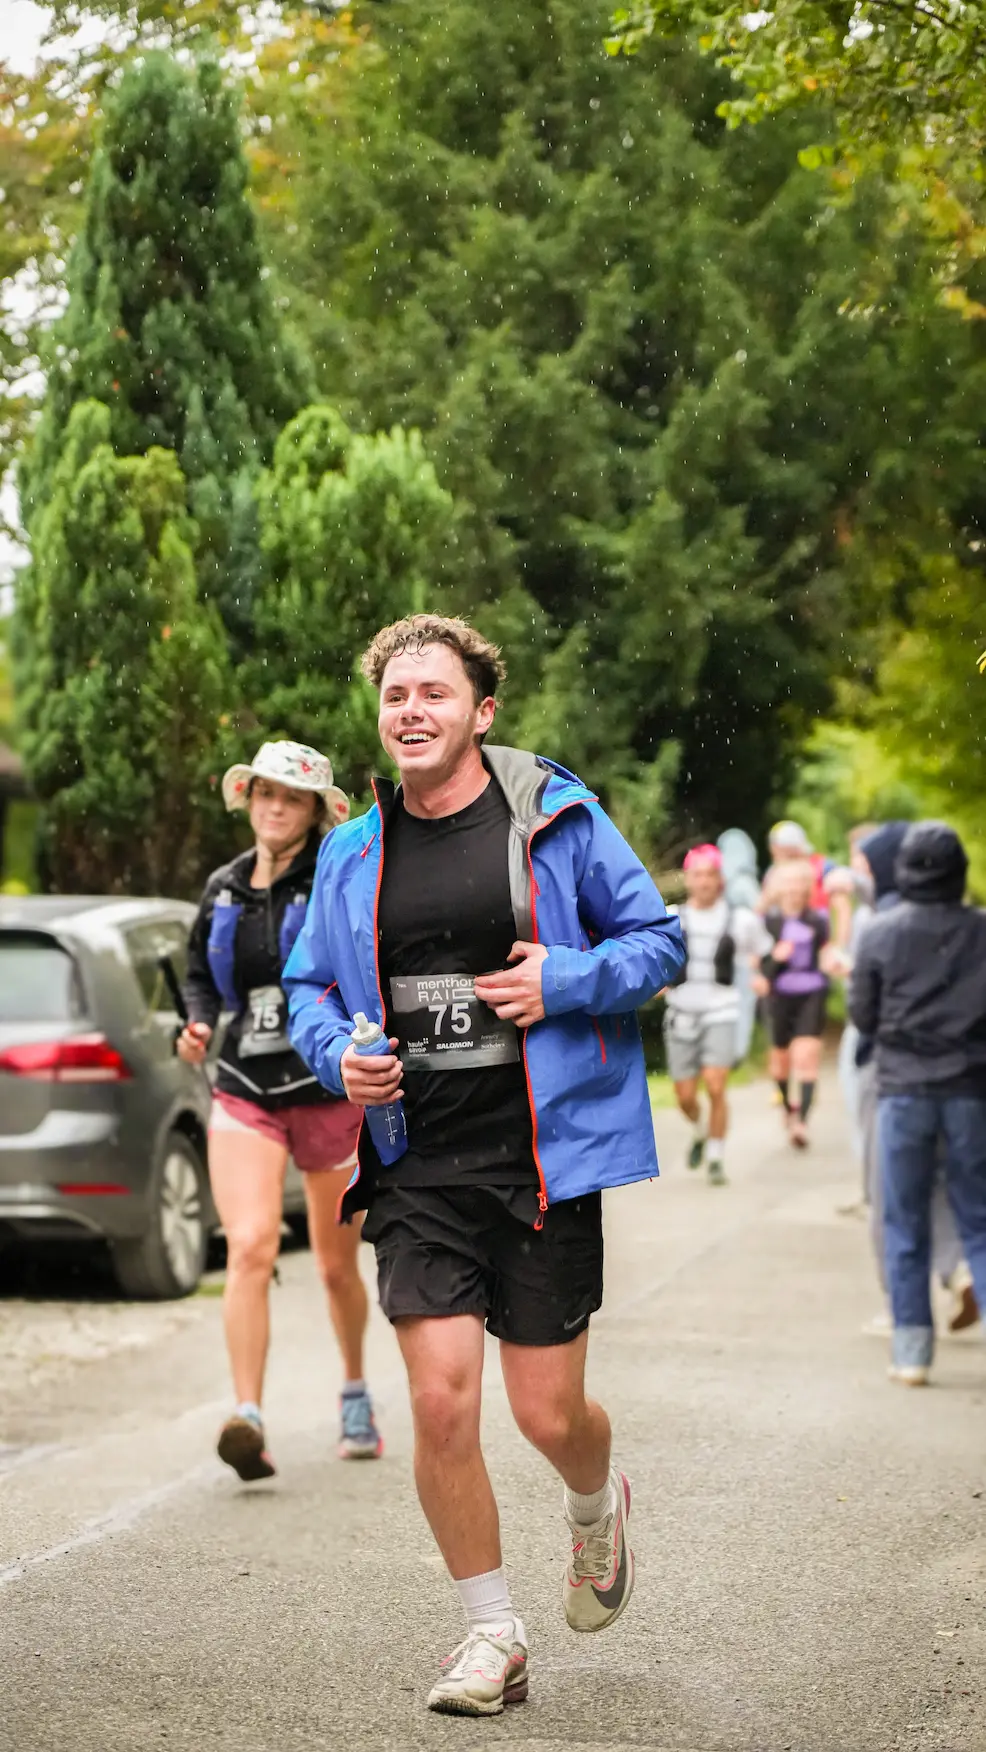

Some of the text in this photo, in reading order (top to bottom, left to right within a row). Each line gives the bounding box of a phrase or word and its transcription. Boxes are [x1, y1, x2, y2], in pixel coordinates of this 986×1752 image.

[251, 1004, 280, 1030] 75
[428, 1002, 472, 1036] 75
[436, 1041, 474, 1050] SALOMON
